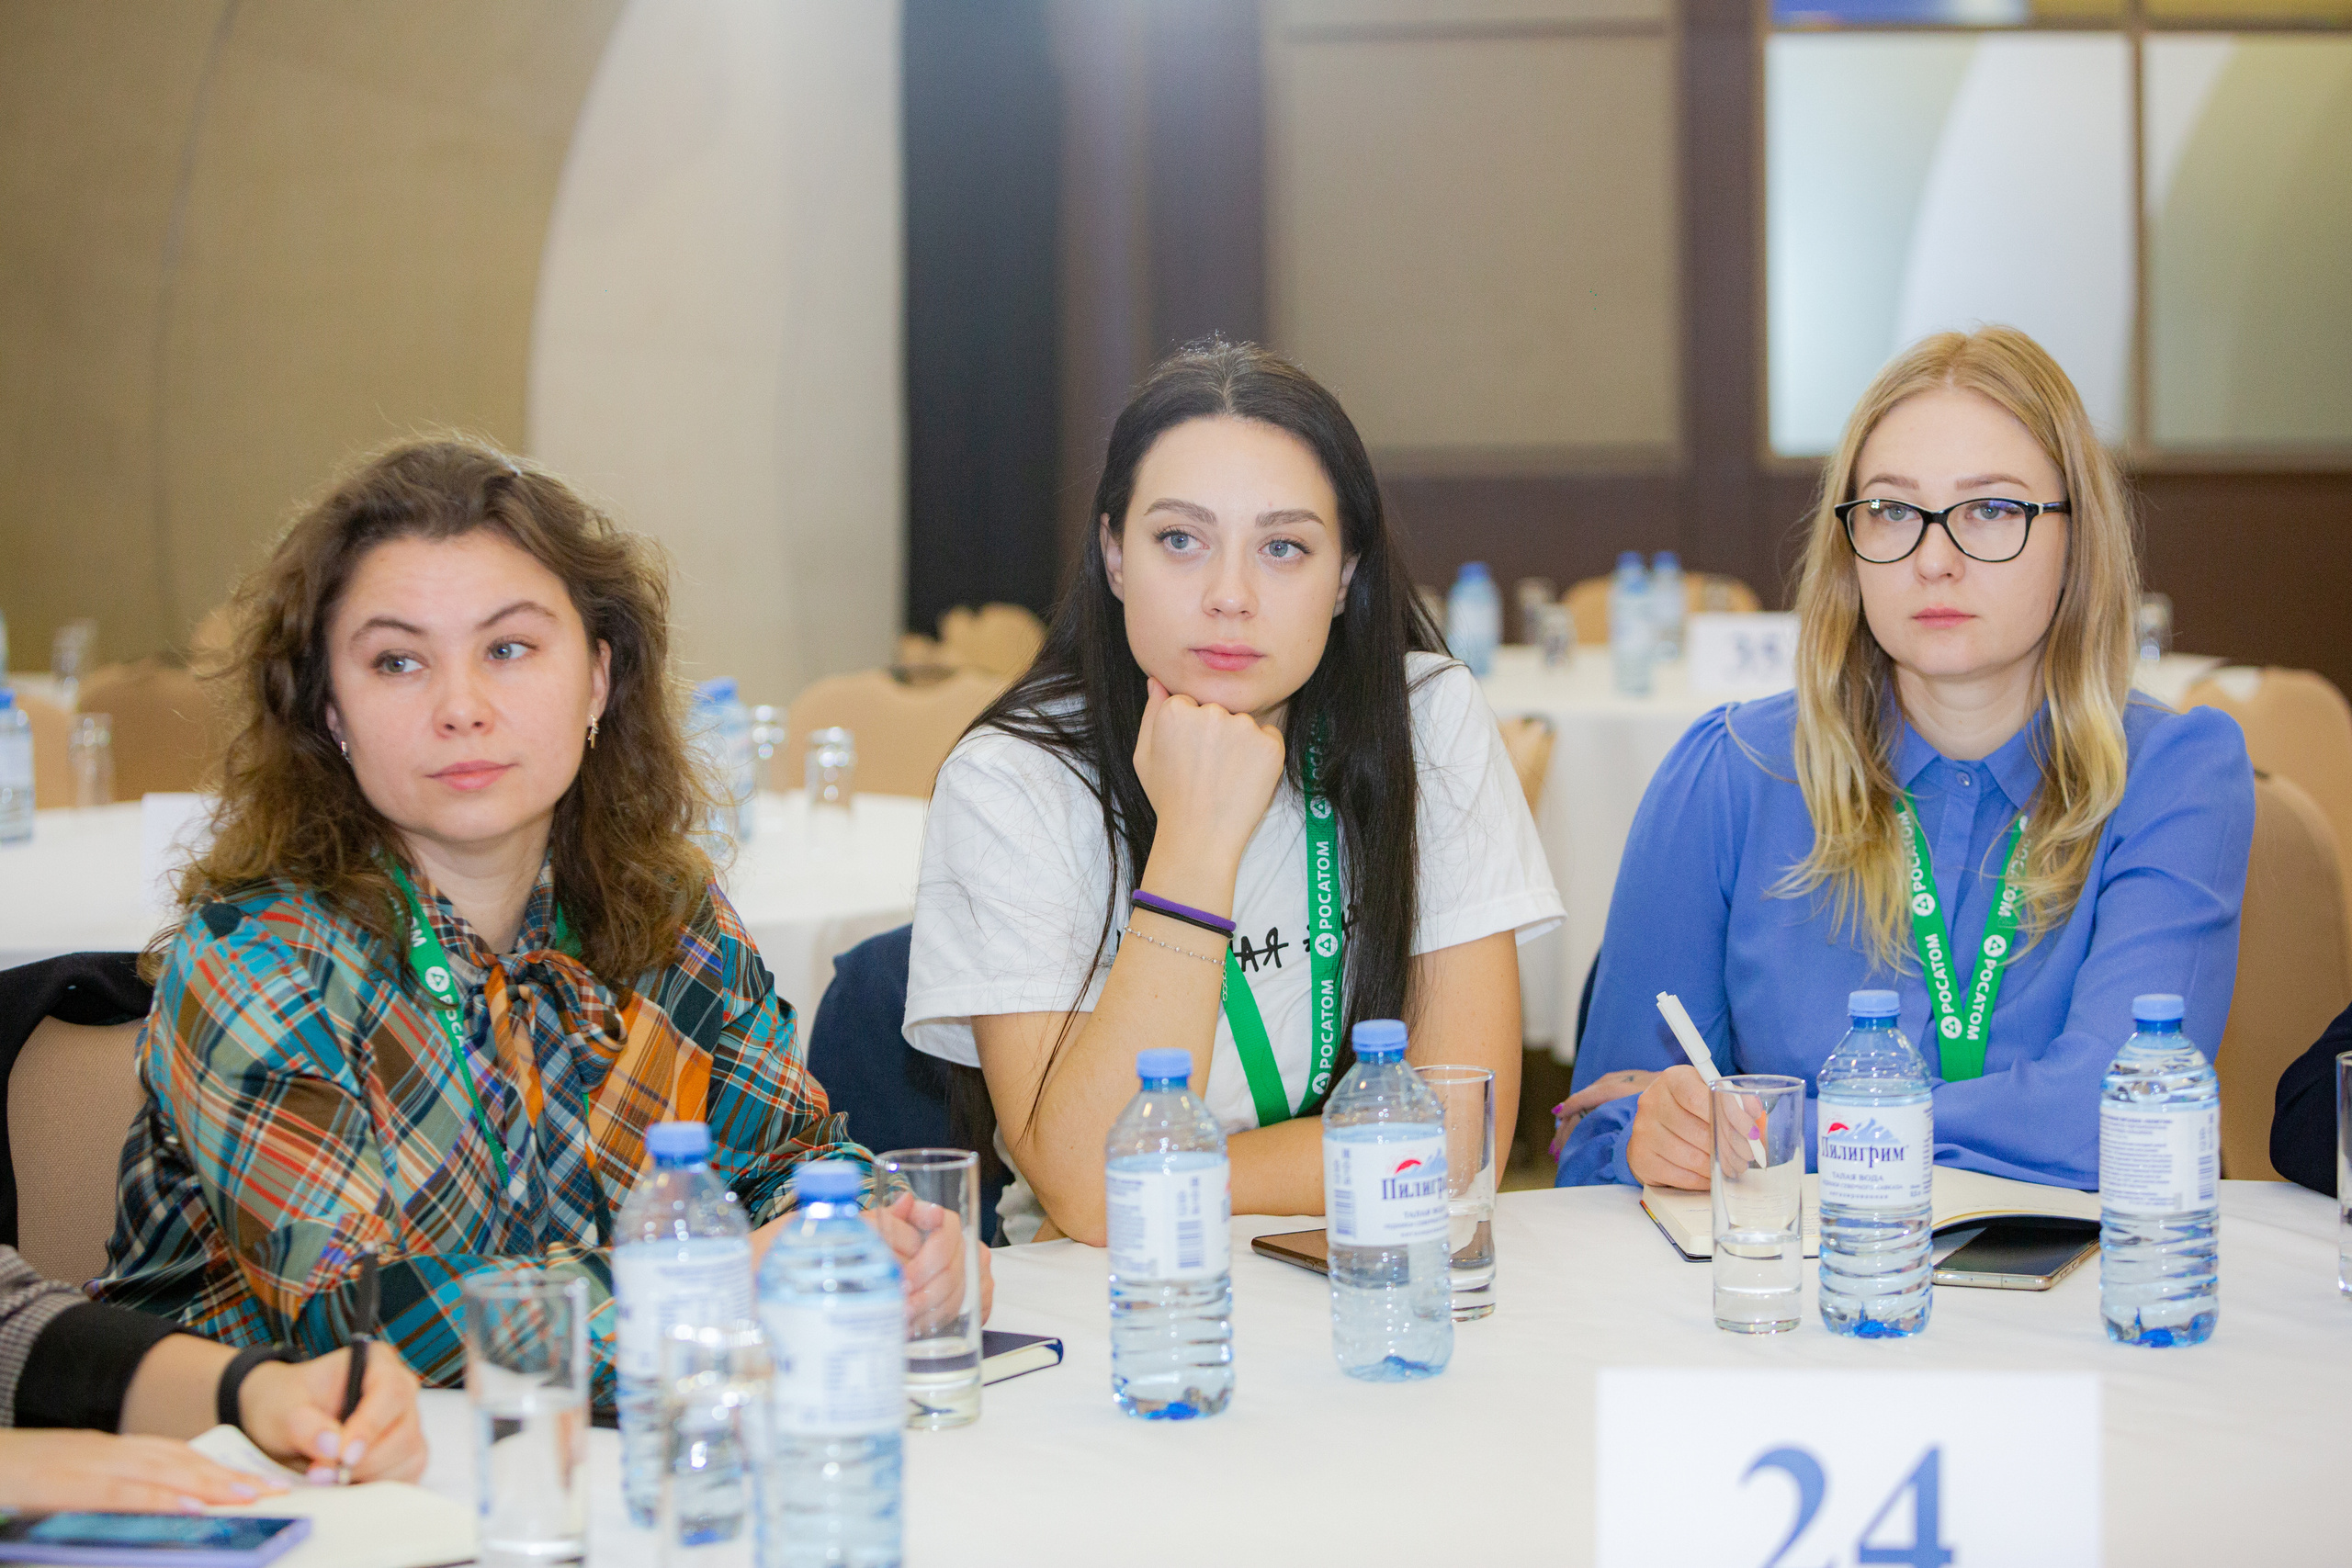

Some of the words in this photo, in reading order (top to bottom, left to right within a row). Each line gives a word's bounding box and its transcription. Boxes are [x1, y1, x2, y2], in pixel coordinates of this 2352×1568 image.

[1317, 840, 1329, 930] РОСАТОМ
[1229, 926, 1289, 972] АЯ
[1925, 933, 1954, 1013] РОСАТОМ
[1321, 979, 1334, 1068] РОСАТОМ
[1967, 959, 1996, 1040] РОСАТОМ
[1382, 1177, 1447, 1200] Пилигр
[1821, 1136, 1905, 1168] Пилигрим
[1740, 1443, 1956, 1568] 24
